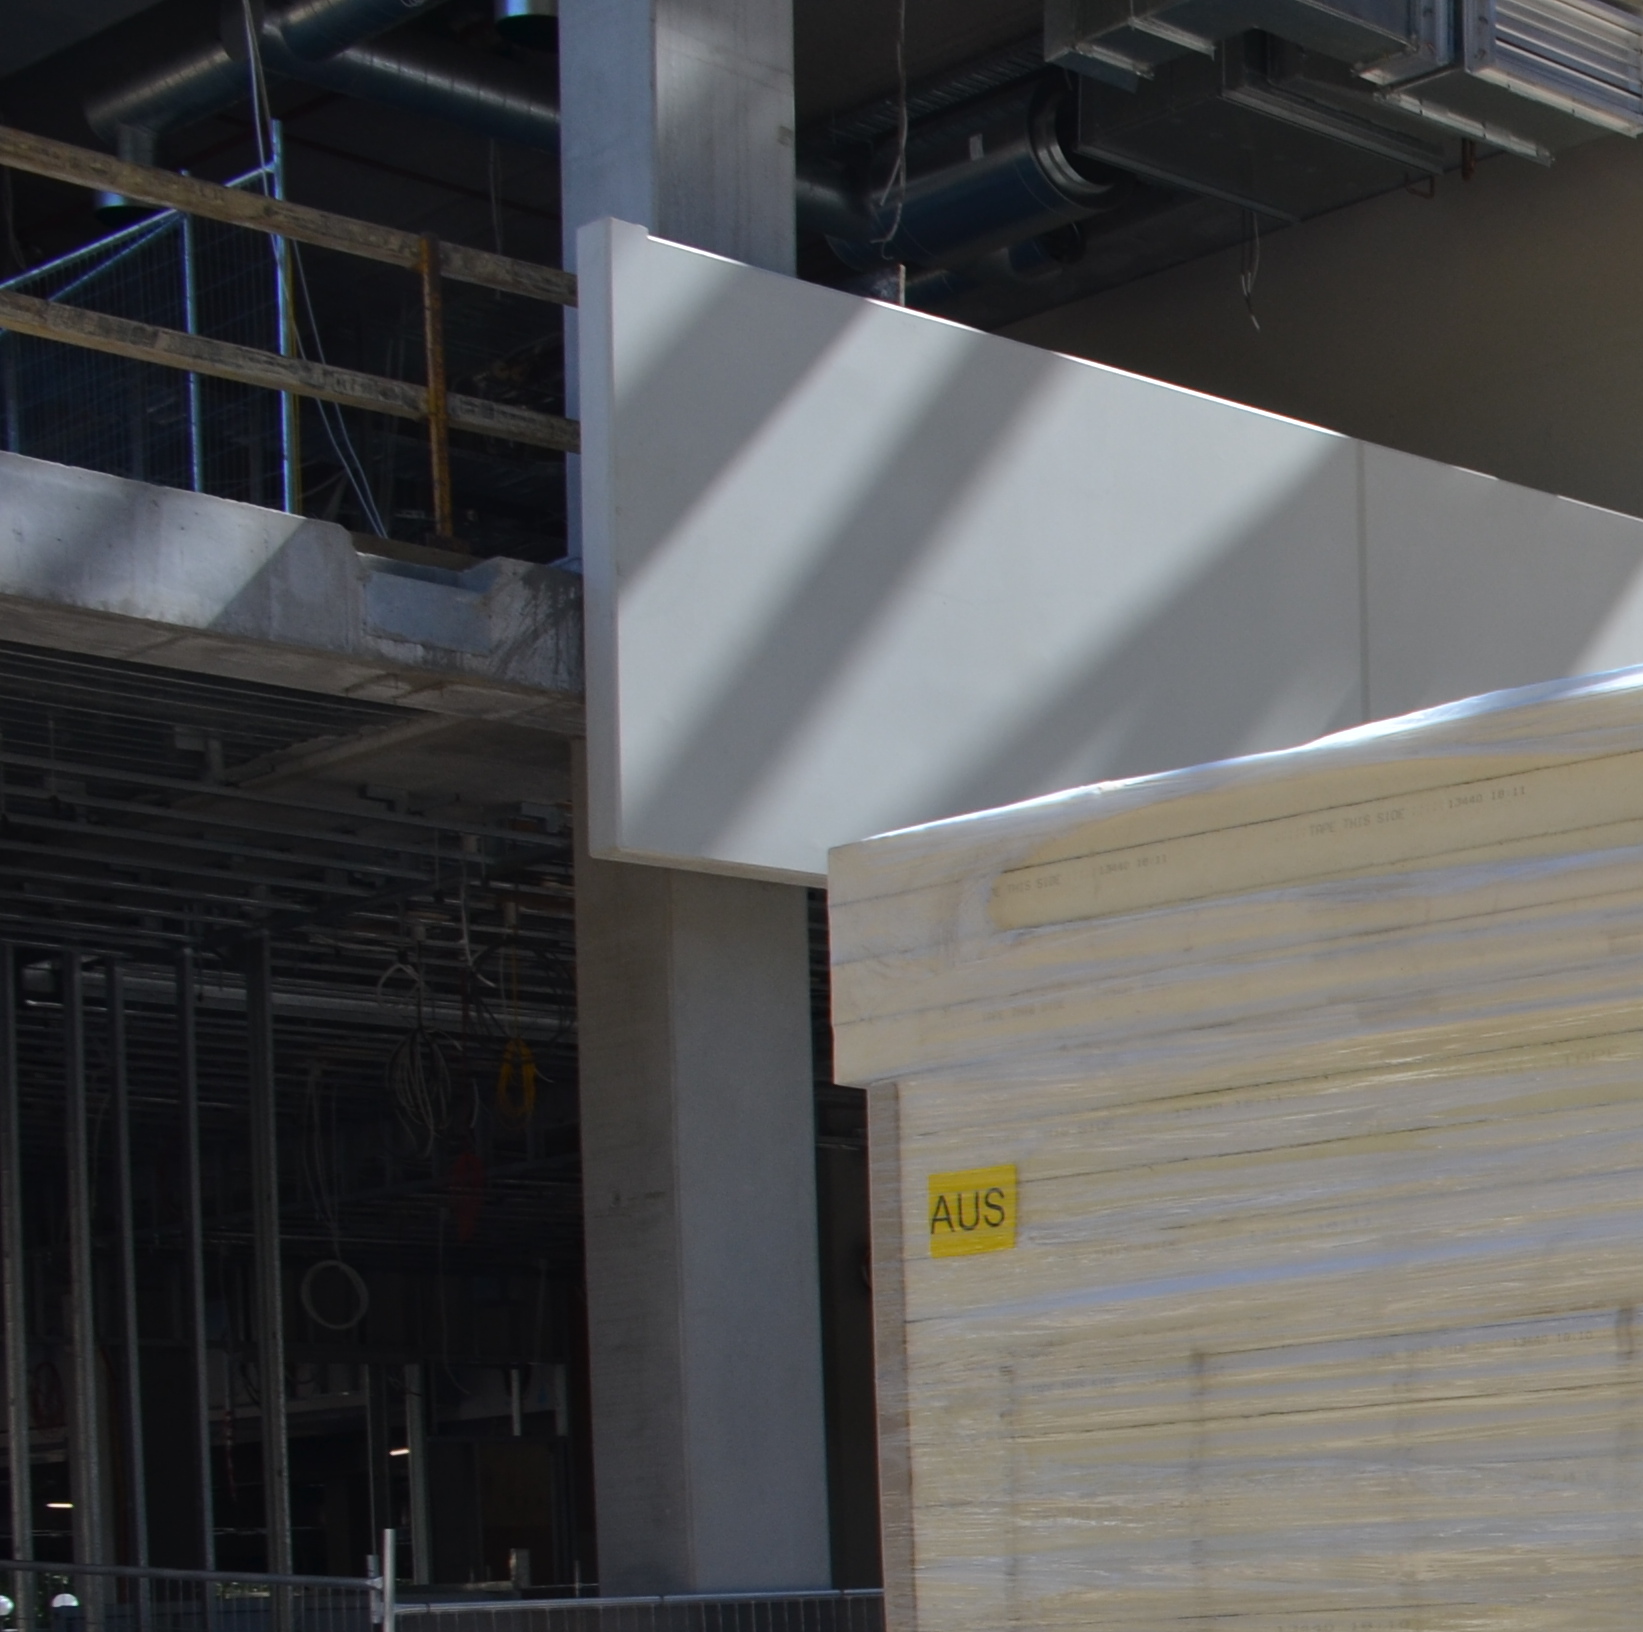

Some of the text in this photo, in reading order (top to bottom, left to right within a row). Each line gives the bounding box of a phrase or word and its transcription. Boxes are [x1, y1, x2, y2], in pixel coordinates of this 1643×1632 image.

[1309, 785, 1526, 837] TAPE THIS SIDE 13440 18:11
[929, 1187, 1007, 1236] AUS
